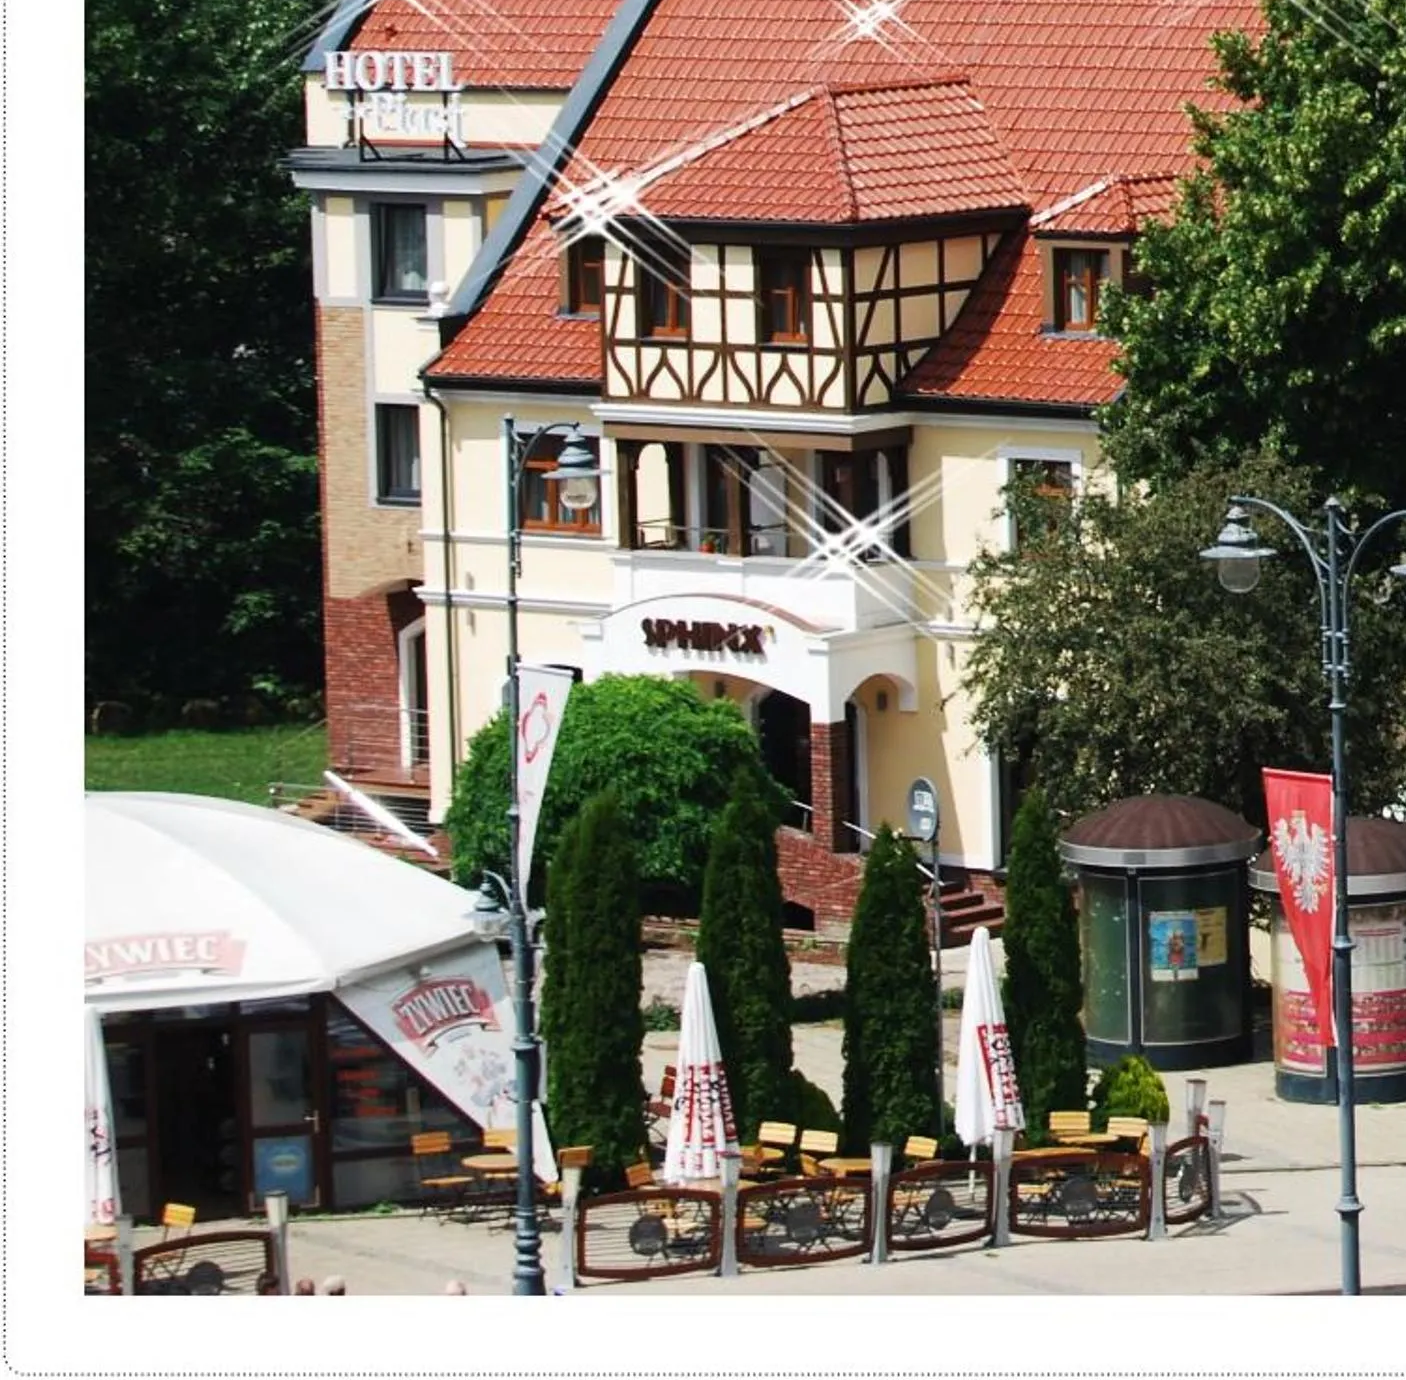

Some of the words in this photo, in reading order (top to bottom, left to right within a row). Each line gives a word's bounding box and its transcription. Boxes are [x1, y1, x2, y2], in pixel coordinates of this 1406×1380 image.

[323, 51, 467, 91] HOTEL
[640, 617, 764, 655] SPHINX
[84, 935, 222, 971] YWIEC
